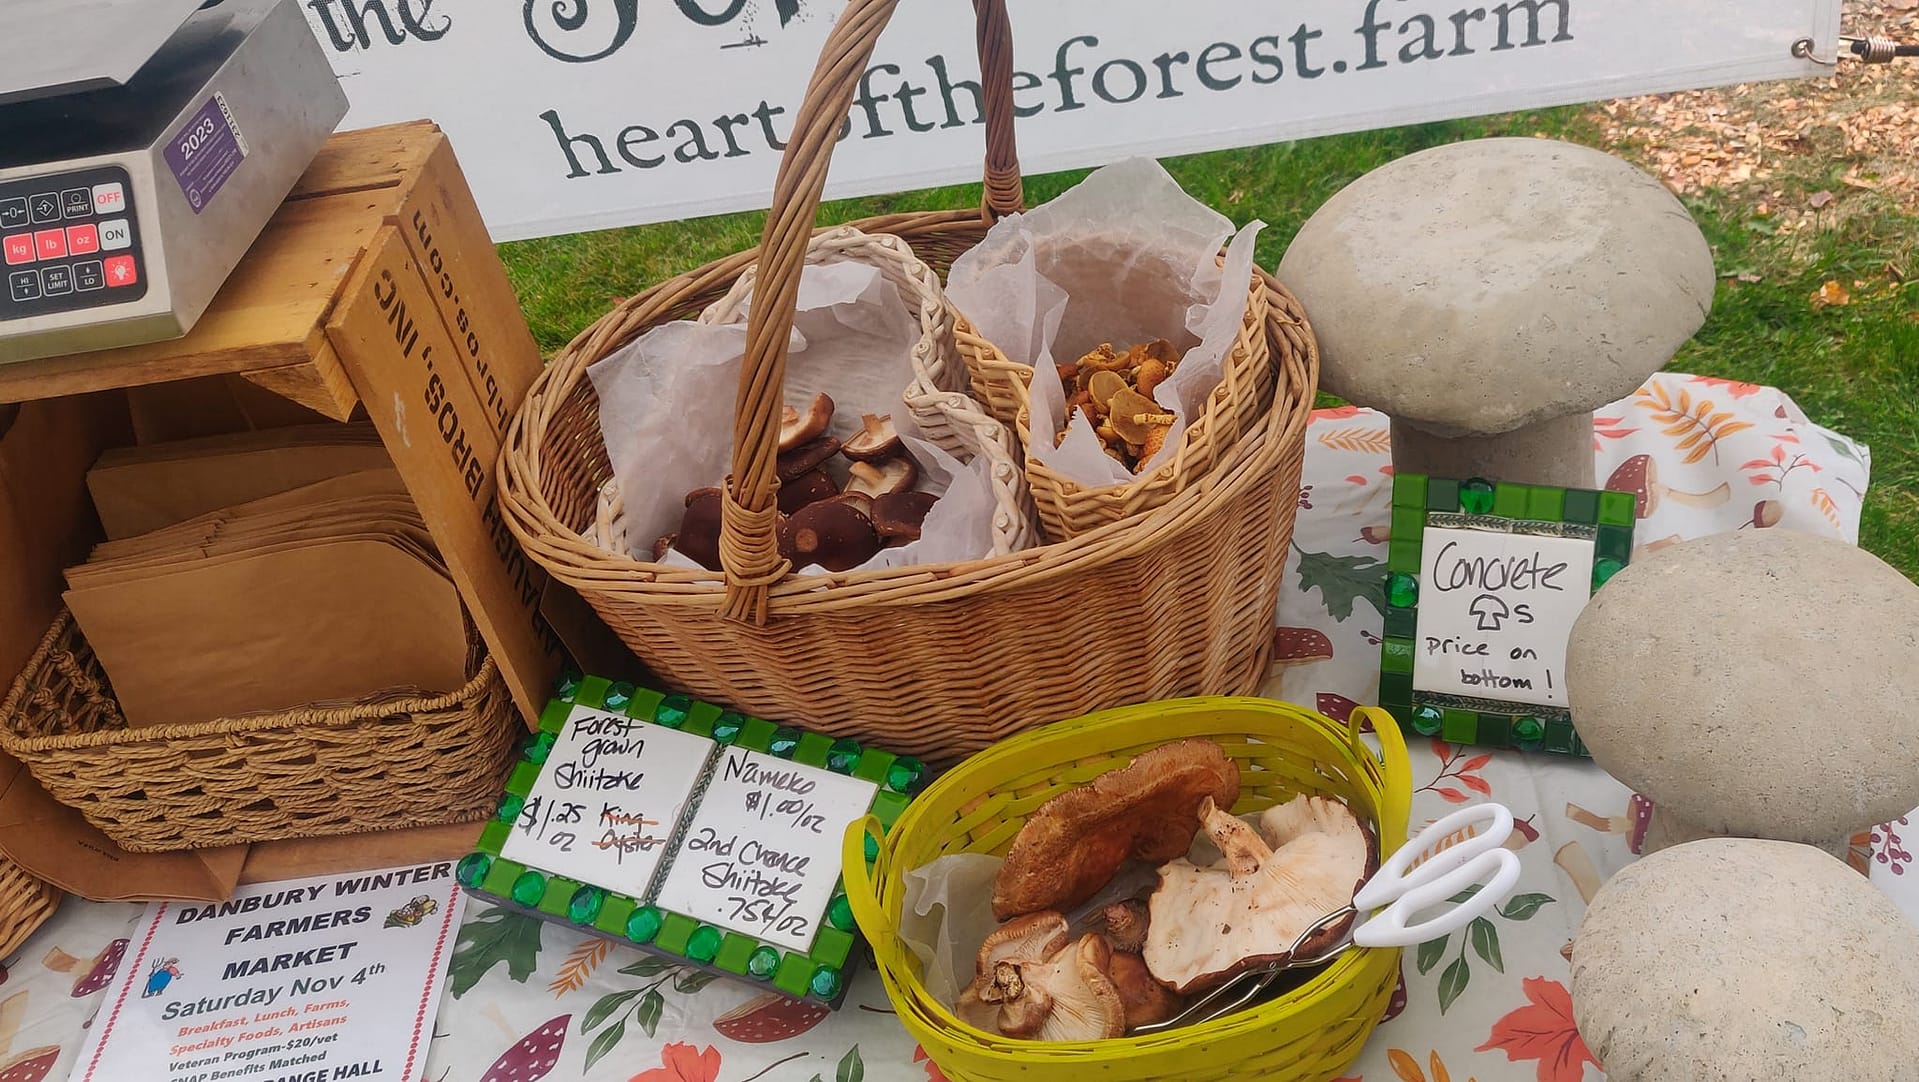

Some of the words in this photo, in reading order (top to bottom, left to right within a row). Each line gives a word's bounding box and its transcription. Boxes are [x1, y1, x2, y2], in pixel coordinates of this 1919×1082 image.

[540, 0, 1574, 179] heartftheforest.farm
[181, 117, 214, 160] 2023
[66, 204, 89, 214] PRINT
[97, 191, 121, 205] OFF
[12, 245, 27, 255] kg
[45, 239, 57, 250] lb
[76, 236, 90, 245] oz
[105, 229, 124, 241] ON
[20, 277, 29, 285] HI
[48, 280, 69, 289] LIMIT
[49, 272, 64, 281] SET
[84, 277, 95, 286] LO
[374, 268, 419, 359] INC
[1433, 541, 1568, 592] Concrete
[1509, 647, 1538, 661] on
[570, 715, 645, 742] Forest
[554, 760, 644, 792] Shiitake
[724, 749, 817, 796] Nameko
[518, 795, 588, 841] $1.25
[687, 827, 739, 857] 2nd
[738, 840, 811, 878] Chance
[175, 884, 328, 925] DANBURY
[334, 862, 452, 897] WINTER
[223, 906, 373, 946] FARMERS
[221, 941, 358, 981] MARKET
[161, 985, 284, 1021] Saturday
[289, 975, 345, 998] Nov
[350, 962, 386, 986] 4th
[177, 1016, 249, 1037] Breakfast,
[253, 1006, 299, 1023] Lunch,
[303, 999, 351, 1014] Farms,
[168, 1035, 235, 1057] Specialty
[237, 1026, 284, 1042] Foods,
[287, 1015, 348, 1034] Artisans
[168, 1055, 220, 1073] Veteran
[223, 1033, 339, 1062] Program-$20/vet
[210, 1063, 266, 1081] Benefits
[268, 1050, 328, 1071] Matched
[332, 1059, 384, 1081] HALL
